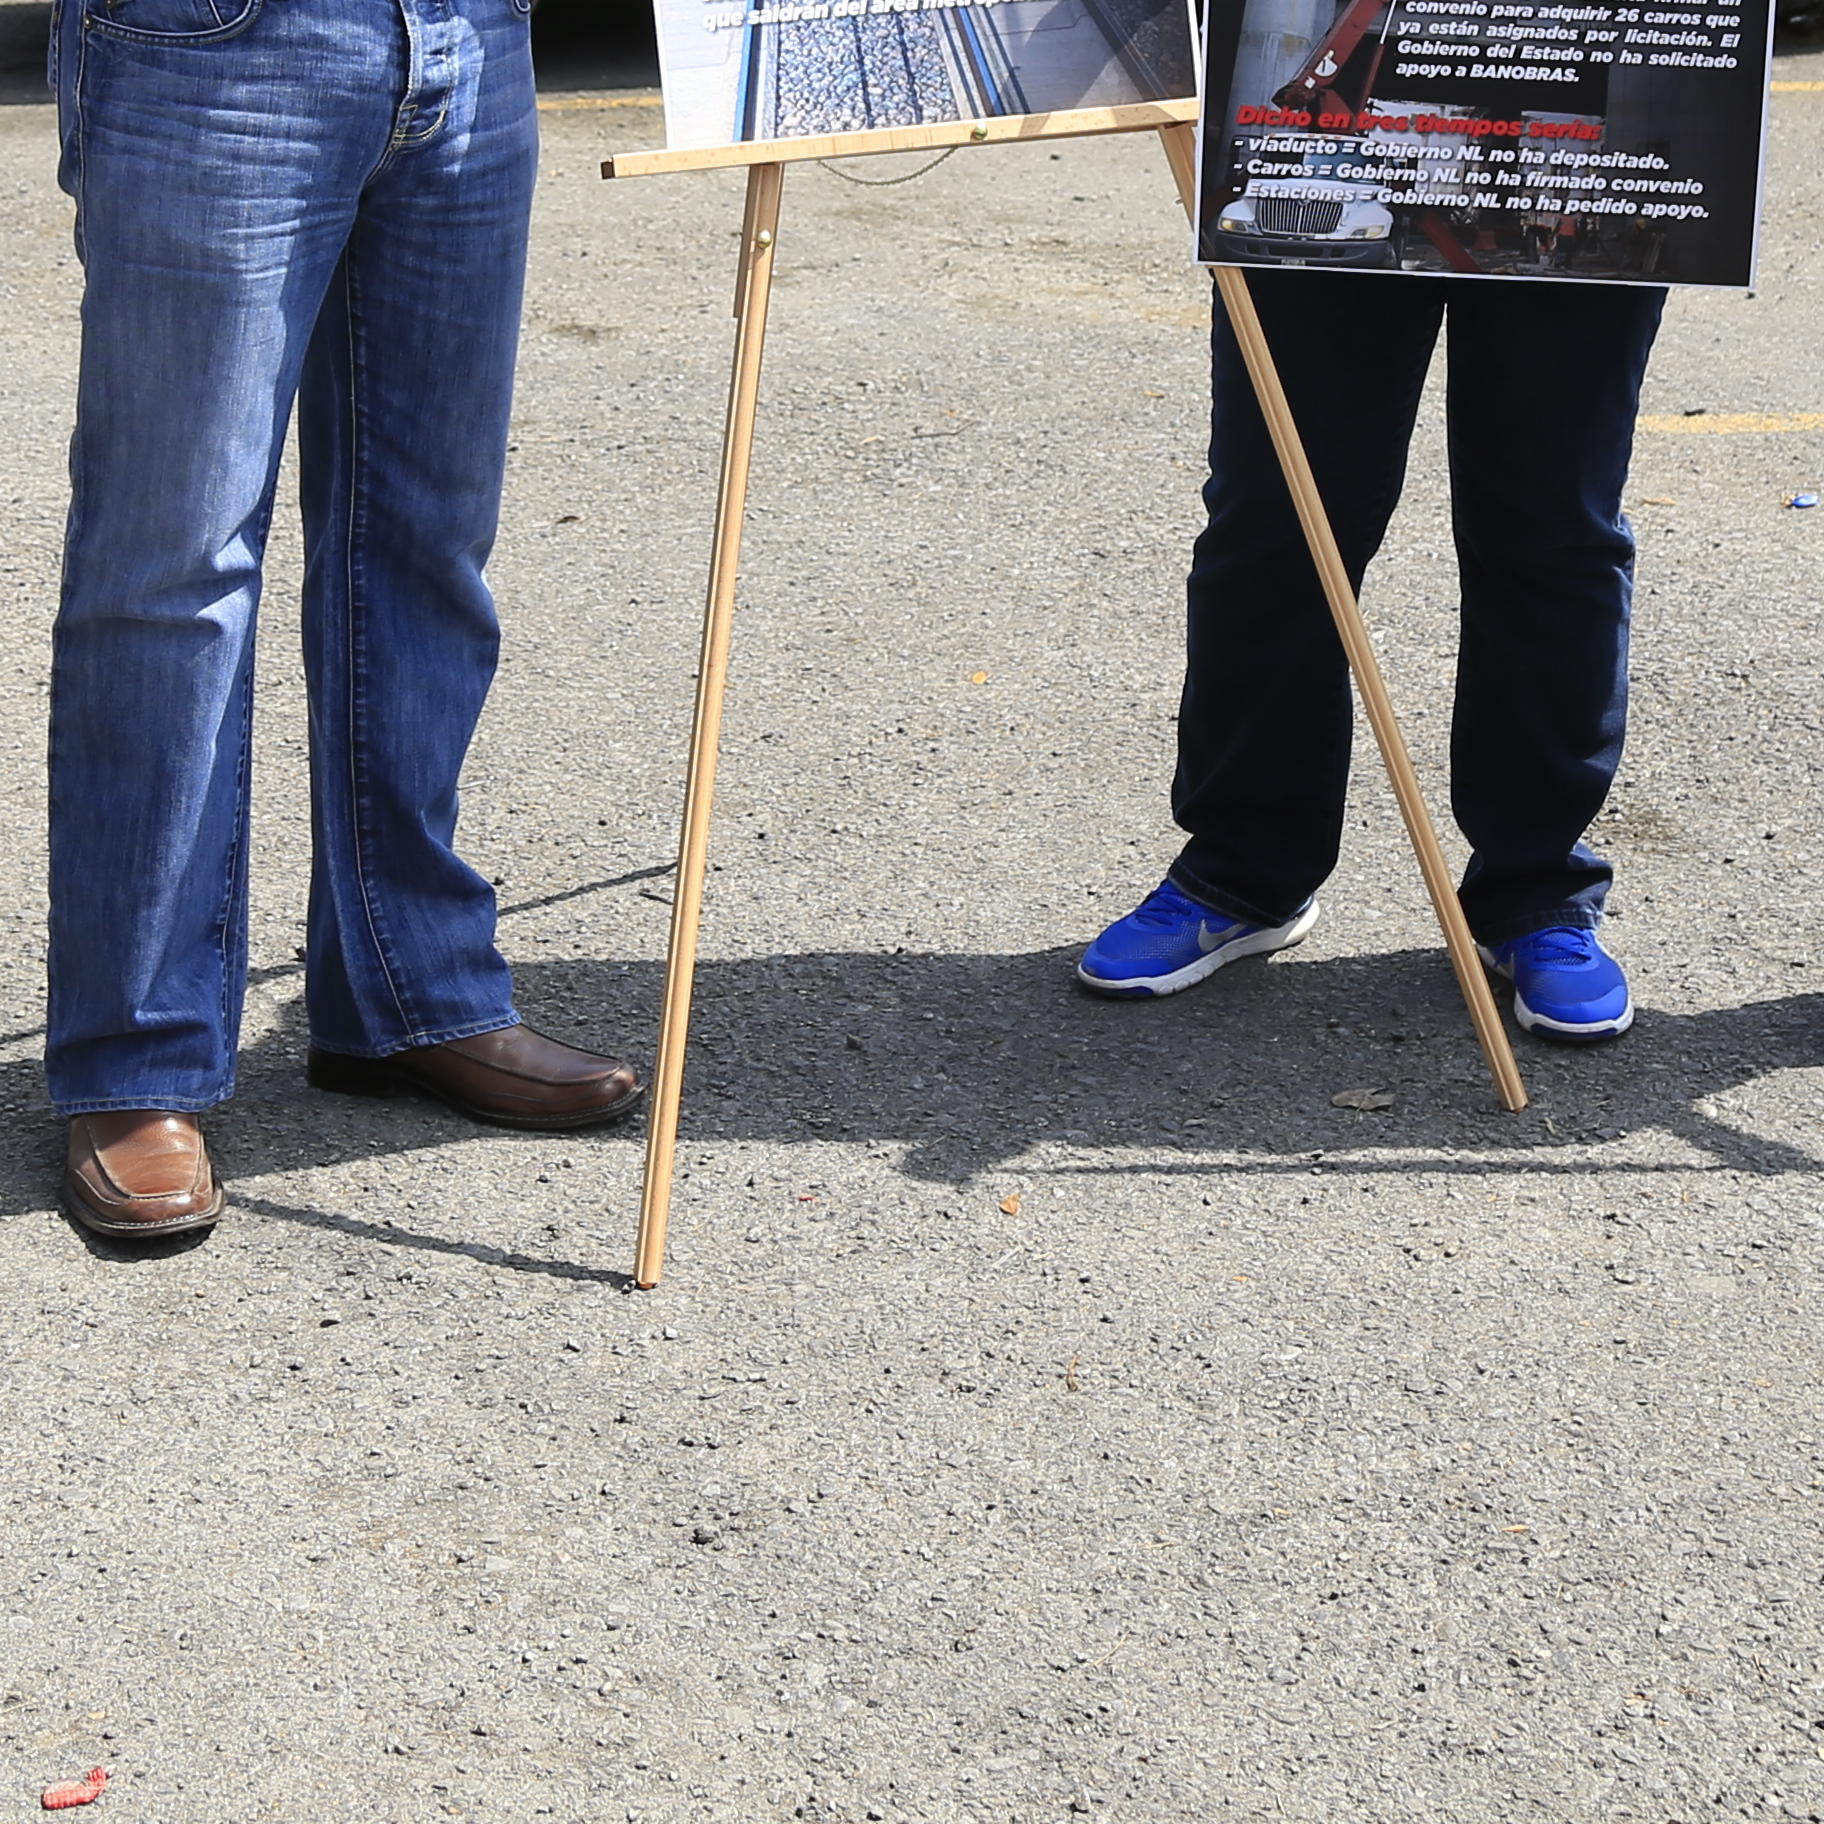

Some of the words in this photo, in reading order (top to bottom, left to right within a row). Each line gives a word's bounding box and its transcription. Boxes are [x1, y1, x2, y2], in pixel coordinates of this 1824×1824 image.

[746, 0, 830, 25] saldrán
[1404, 0, 1489, 17] convenio
[1489, 3, 1535, 20] para
[1536, 3, 1614, 24] adquirir
[1613, 6, 1641, 24] 26
[1642, 10, 1703, 27] carros
[1704, 13, 1742, 30] que
[1396, 20, 1423, 37] ya
[1427, 19, 1481, 37] están
[1484, 22, 1580, 42] asignados
[1582, 29, 1620, 45] por
[1623, 27, 1714, 48] licitación.
[1719, 32, 1741, 49] El
[1396, 38, 1481, 58] Gobierno
[1485, 42, 1517, 60] del
[1518, 44, 1585, 63] Estado
[1588, 50, 1615, 64] no
[1617, 48, 1644, 65] ha
[1647, 50, 1739, 70] solicitado
[1394, 62, 1453, 80] apoyo
[1468, 62, 1581, 83] BANOBRAS.
[1236, 104, 1312, 127] Dicho
[1317, 112, 1351, 129] en
[1356, 112, 1410, 131] tres
[1415, 115, 1523, 138] tiempos
[1529, 122, 1601, 140] sería:
[1247, 134, 1340, 156] viaducto
[1358, 139, 1455, 162] Gobierno
[1453, 143, 1486, 162] NL
[1487, 148, 1517, 164] no
[1517, 146, 1547, 165] ha
[1548, 148, 1671, 171] depositado.
[1245, 157, 1316, 178] Carros
[1335, 161, 1432, 185] Gobierno
[1430, 165, 1463, 186] NL
[1463, 171, 1493, 186] no
[1493, 168, 1523, 187] ha
[1524, 170, 1608, 191] firmado
[1610, 177, 1705, 196] convenio
[1241, 180, 1357, 204] Estaciones
[1374, 186, 1471, 208] Gobierno
[1471, 191, 1503, 210] NL
[1504, 195, 1534, 211] no
[1534, 193, 1563, 212] ha
[1563, 196, 1638, 216] pedido
[1639, 202, 1710, 221] apoyo.
